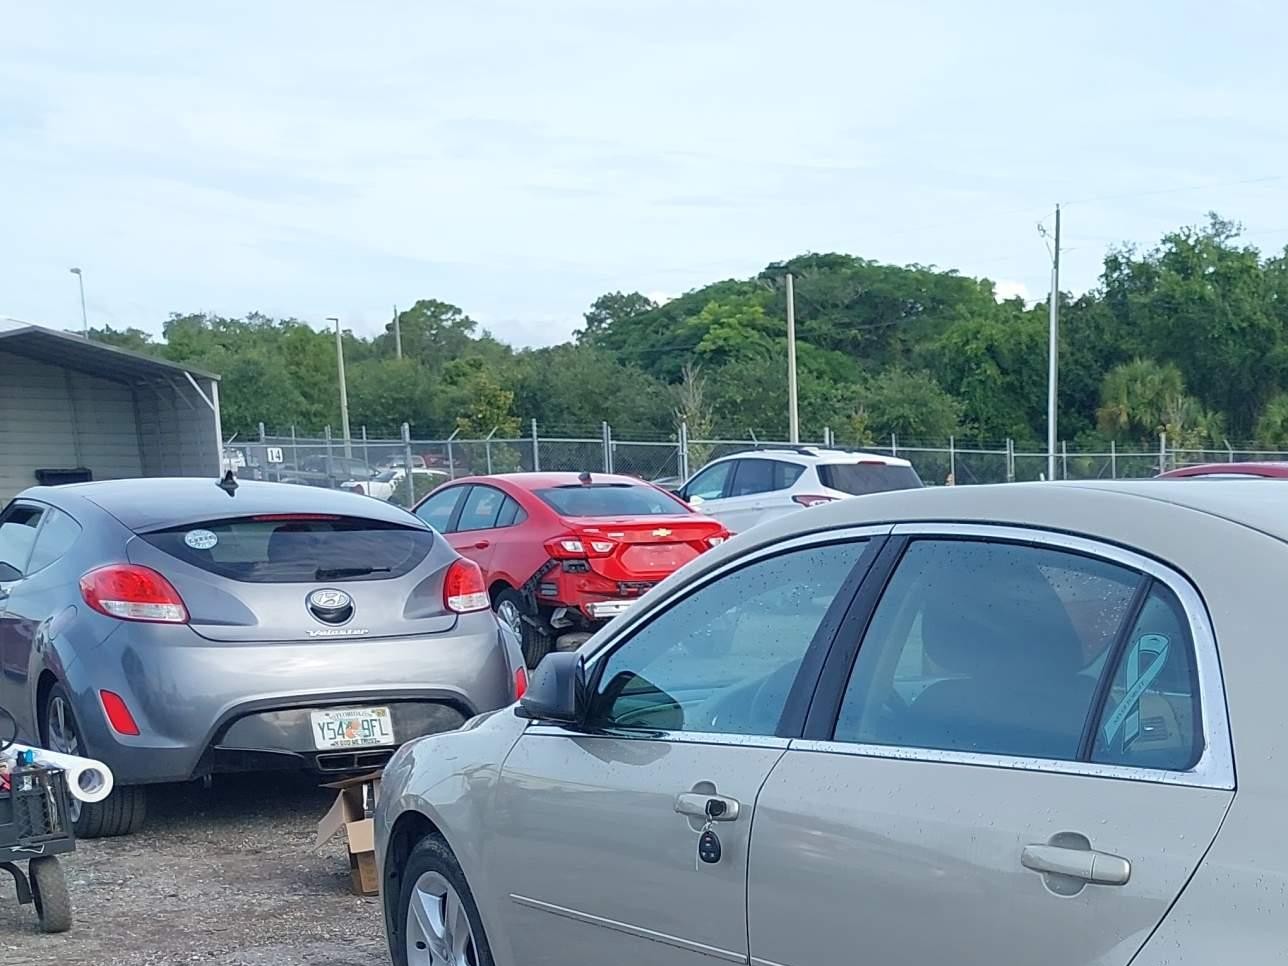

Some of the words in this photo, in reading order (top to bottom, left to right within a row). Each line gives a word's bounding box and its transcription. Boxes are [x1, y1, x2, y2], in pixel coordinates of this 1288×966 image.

[270, 449, 281, 461] 14
[318, 720, 346, 741] Y54
[361, 719, 389, 737] 9FL
